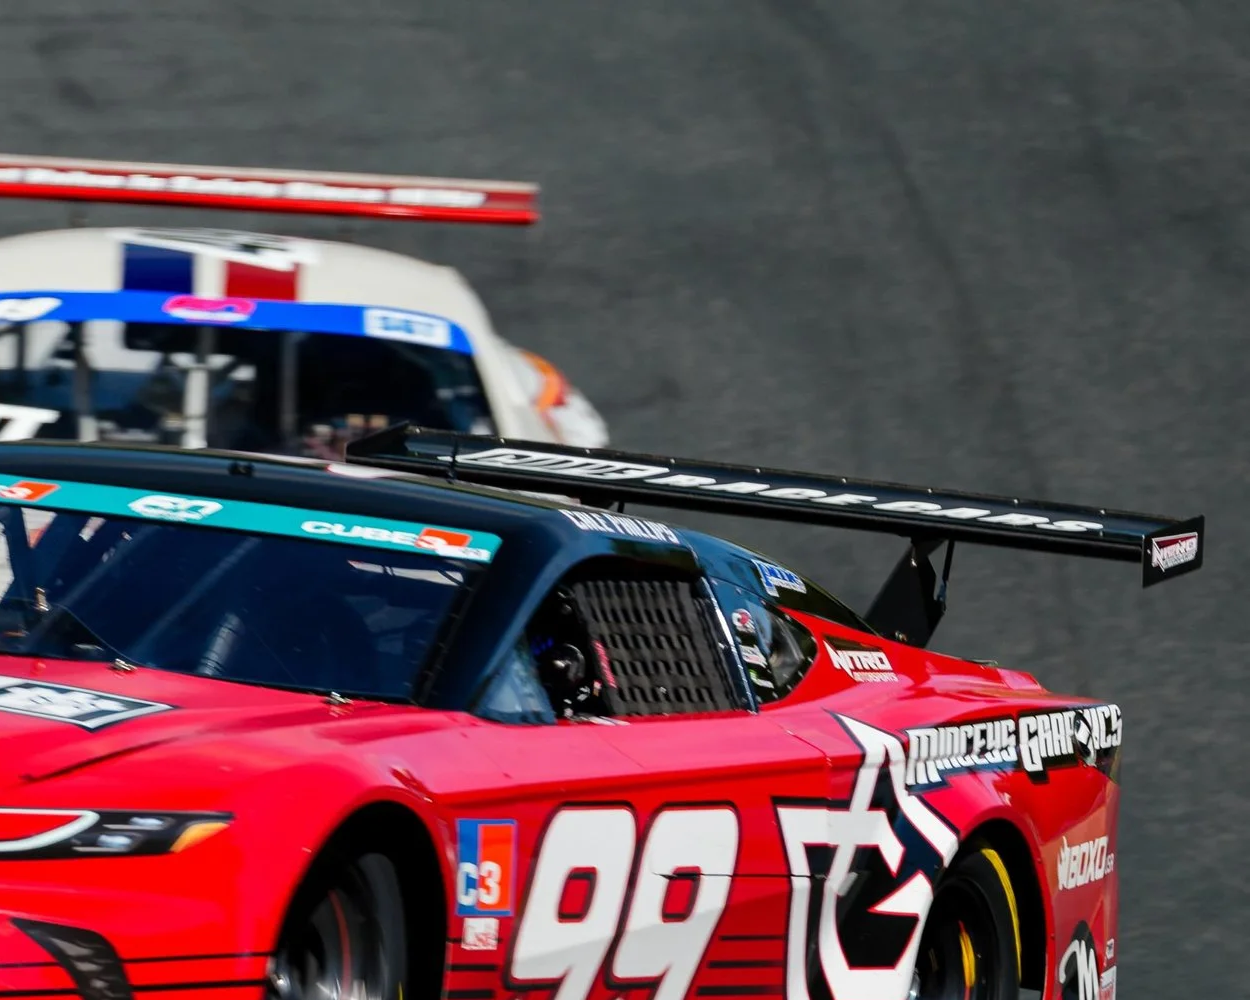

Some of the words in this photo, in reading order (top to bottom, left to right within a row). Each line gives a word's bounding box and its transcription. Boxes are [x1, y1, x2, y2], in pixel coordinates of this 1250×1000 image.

[644, 474, 878, 506] RACE
[872, 500, 1104, 532] CARS
[823, 641, 893, 677] NITRO
[458, 860, 501, 907] C3
